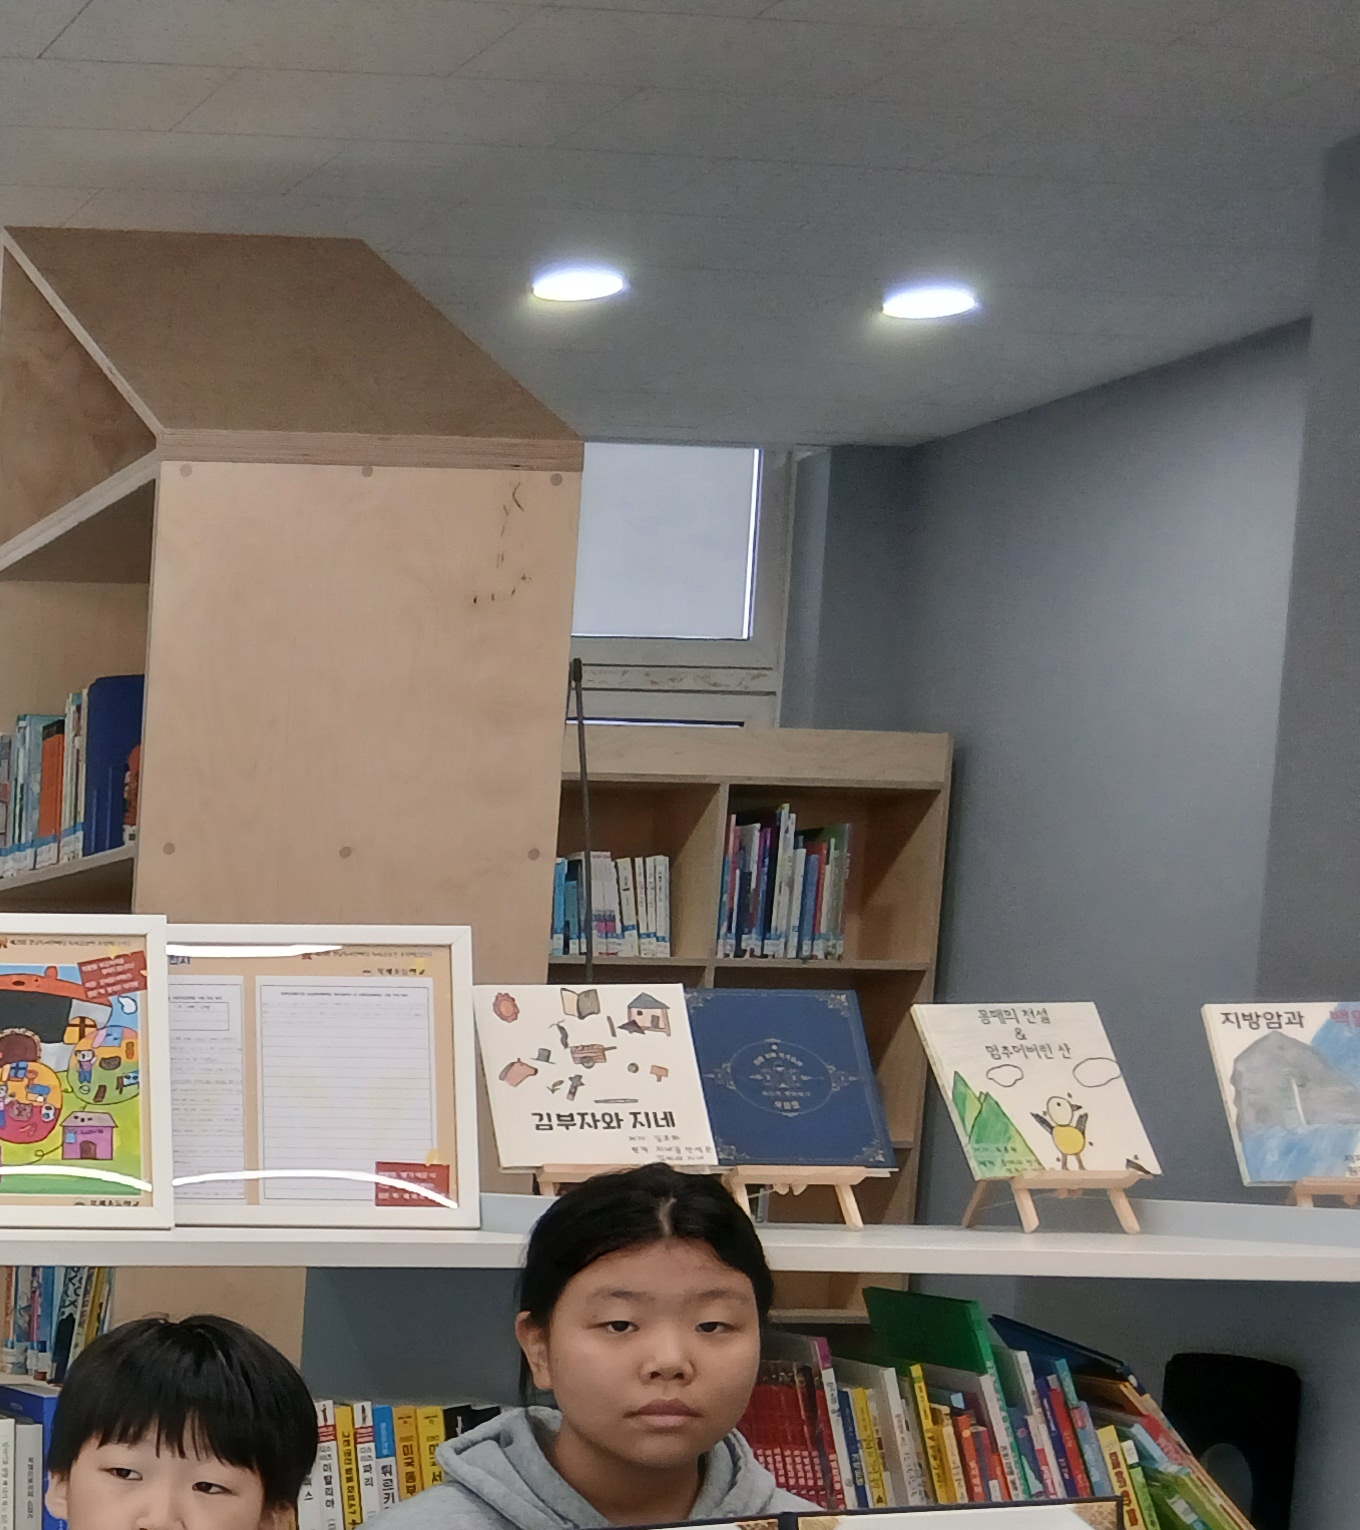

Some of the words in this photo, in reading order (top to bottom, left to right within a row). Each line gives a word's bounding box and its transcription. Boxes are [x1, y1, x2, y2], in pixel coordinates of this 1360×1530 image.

[1021, 1008, 1051, 1024] 전설
[1220, 1010, 1305, 1030] 지방암과
[1015, 1027, 1027, 1041] &
[985, 1045, 1053, 1061] 멈추어버린
[1057, 1043, 1072, 1059] 산
[532, 1111, 624, 1131] 김부자와
[631, 1111, 676, 1129] 지네
[362, 1463, 375, 1488] 파리
[322, 1463, 336, 1509] 이탈리아
[381, 1464, 396, 1510] 튀르키
